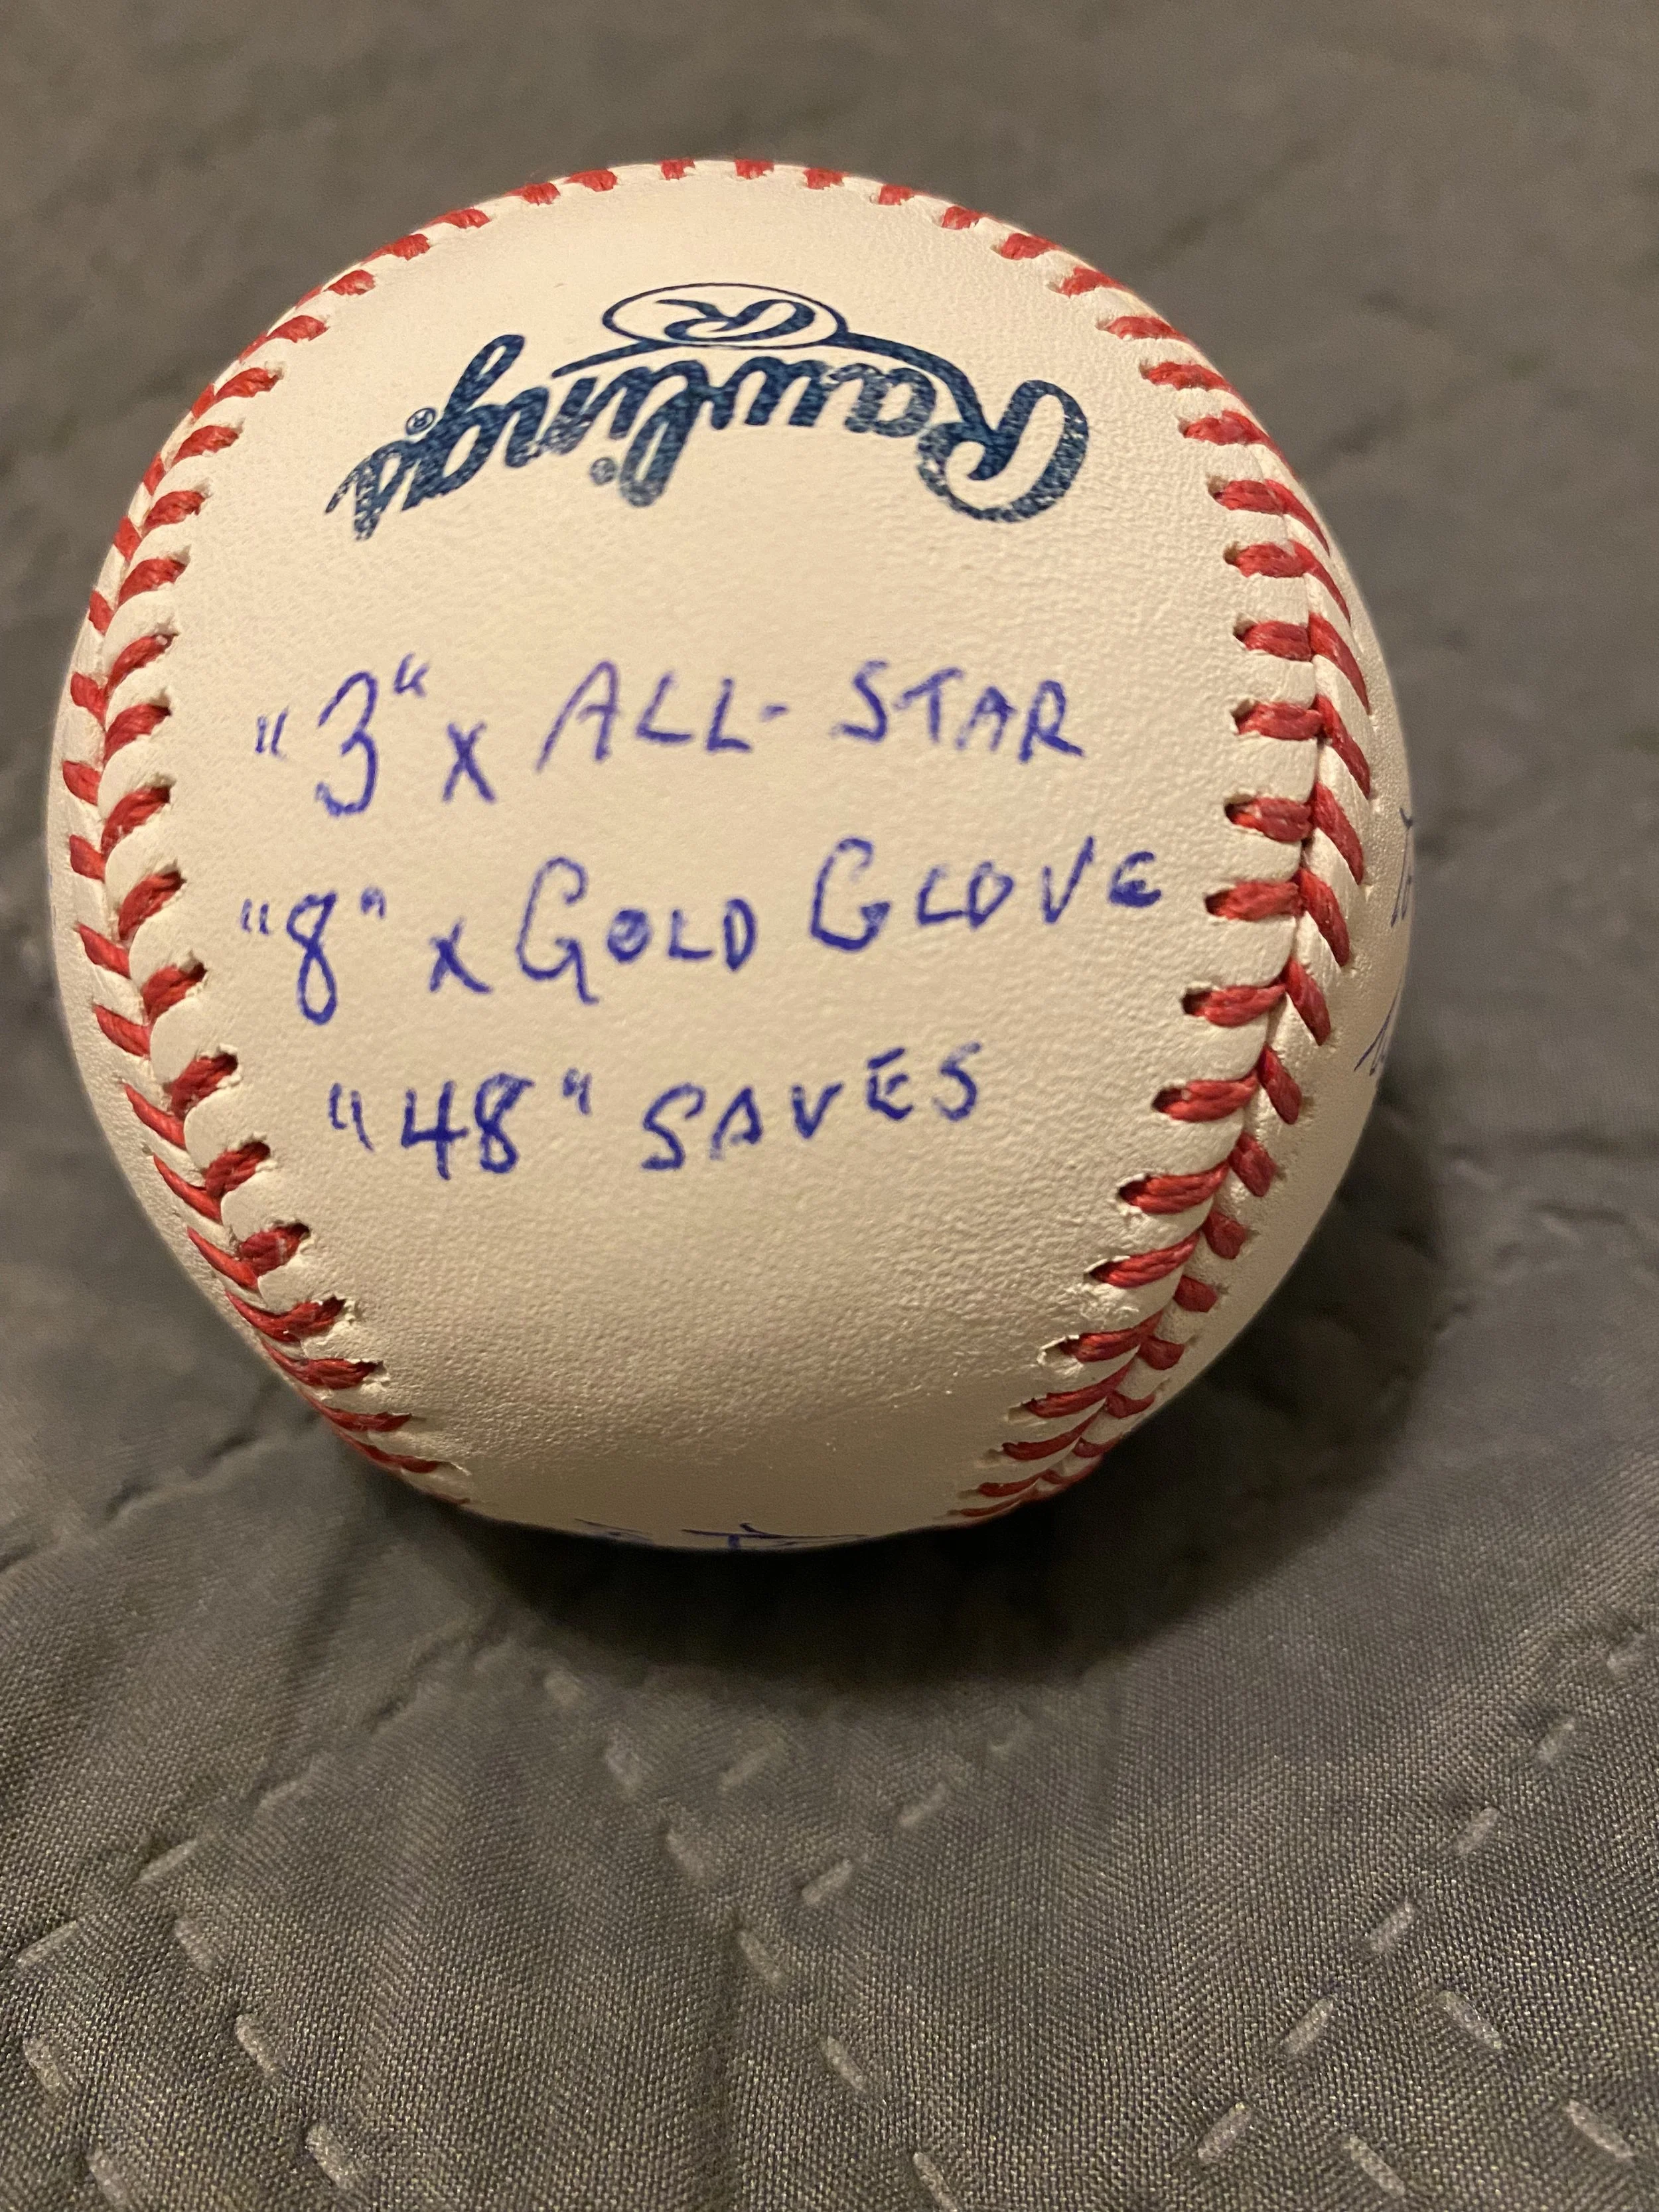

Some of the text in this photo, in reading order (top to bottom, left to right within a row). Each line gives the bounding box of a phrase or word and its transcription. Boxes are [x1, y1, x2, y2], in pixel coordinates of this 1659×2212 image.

[514, 856, 759, 1005] GOLD
[808, 835, 1164, 953] GLOVE
[640, 1042, 983, 1172] SAVES
